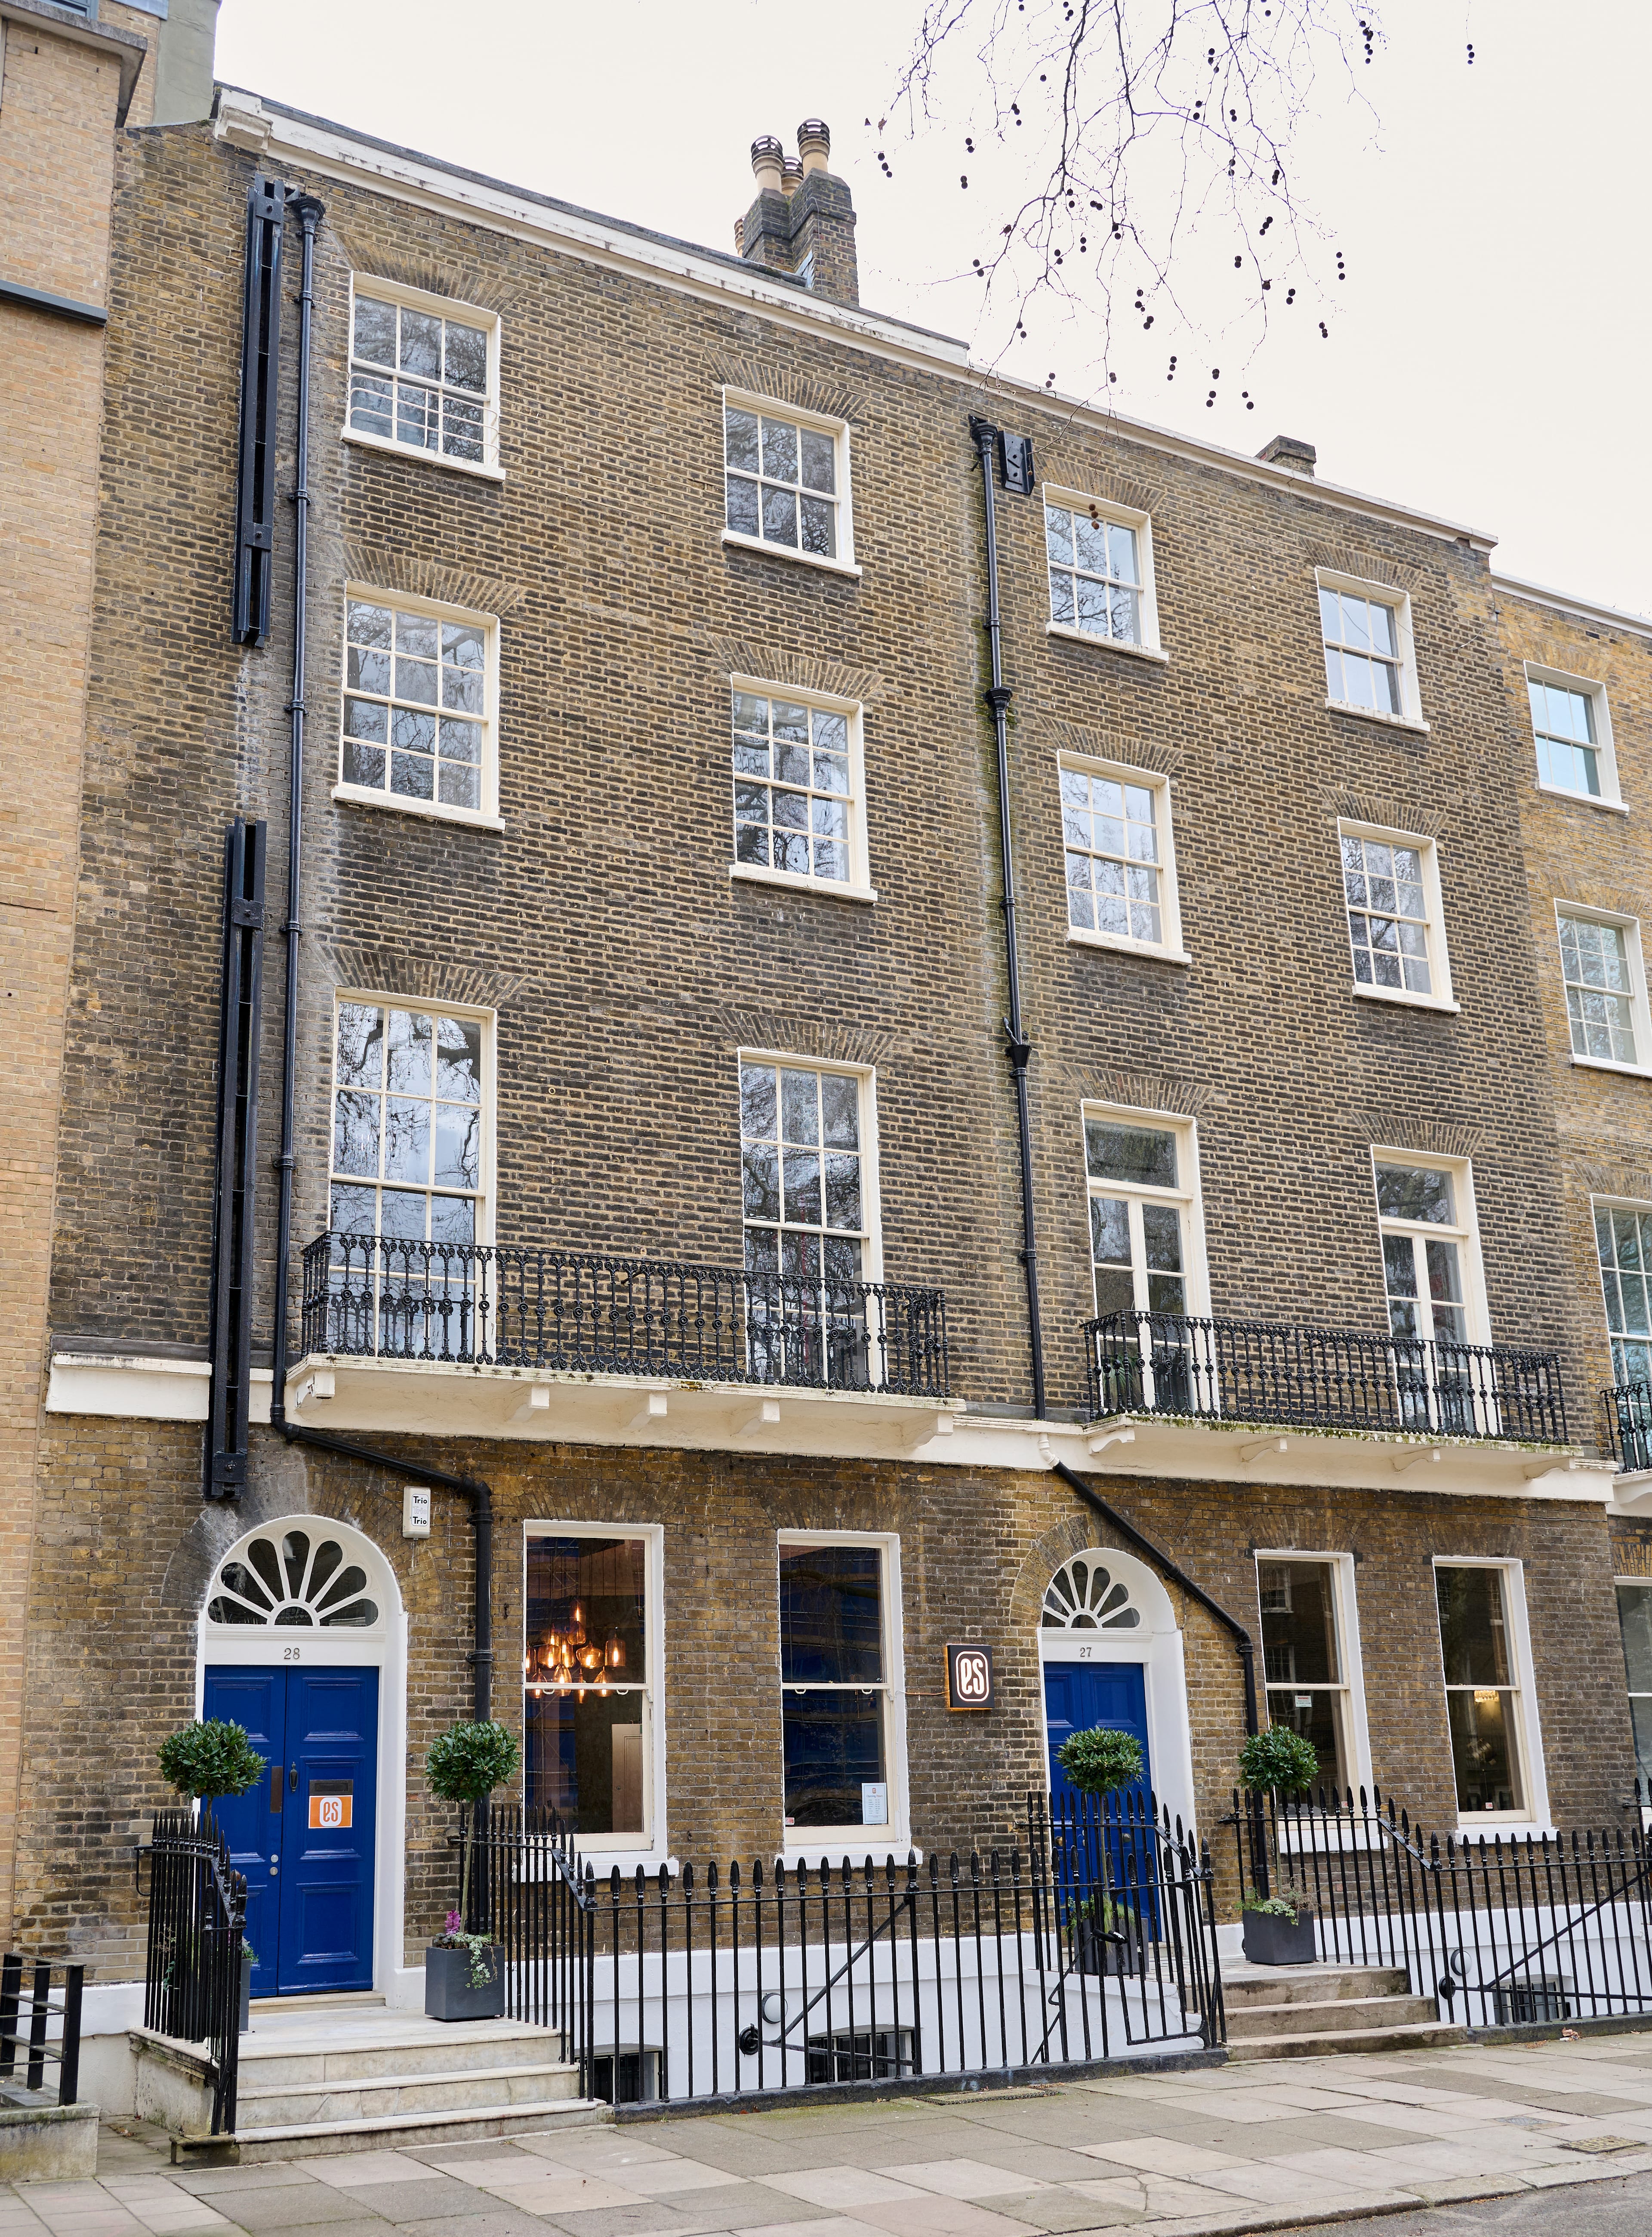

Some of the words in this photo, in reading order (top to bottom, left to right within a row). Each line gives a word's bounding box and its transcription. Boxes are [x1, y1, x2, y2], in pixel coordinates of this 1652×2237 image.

[413, 1496, 427, 1504] Trio
[413, 1506, 427, 1514] Trio
[413, 1516, 427, 1524] Trio
[284, 1648, 300, 1660] 28
[1080, 1647, 1092, 1657] 27
